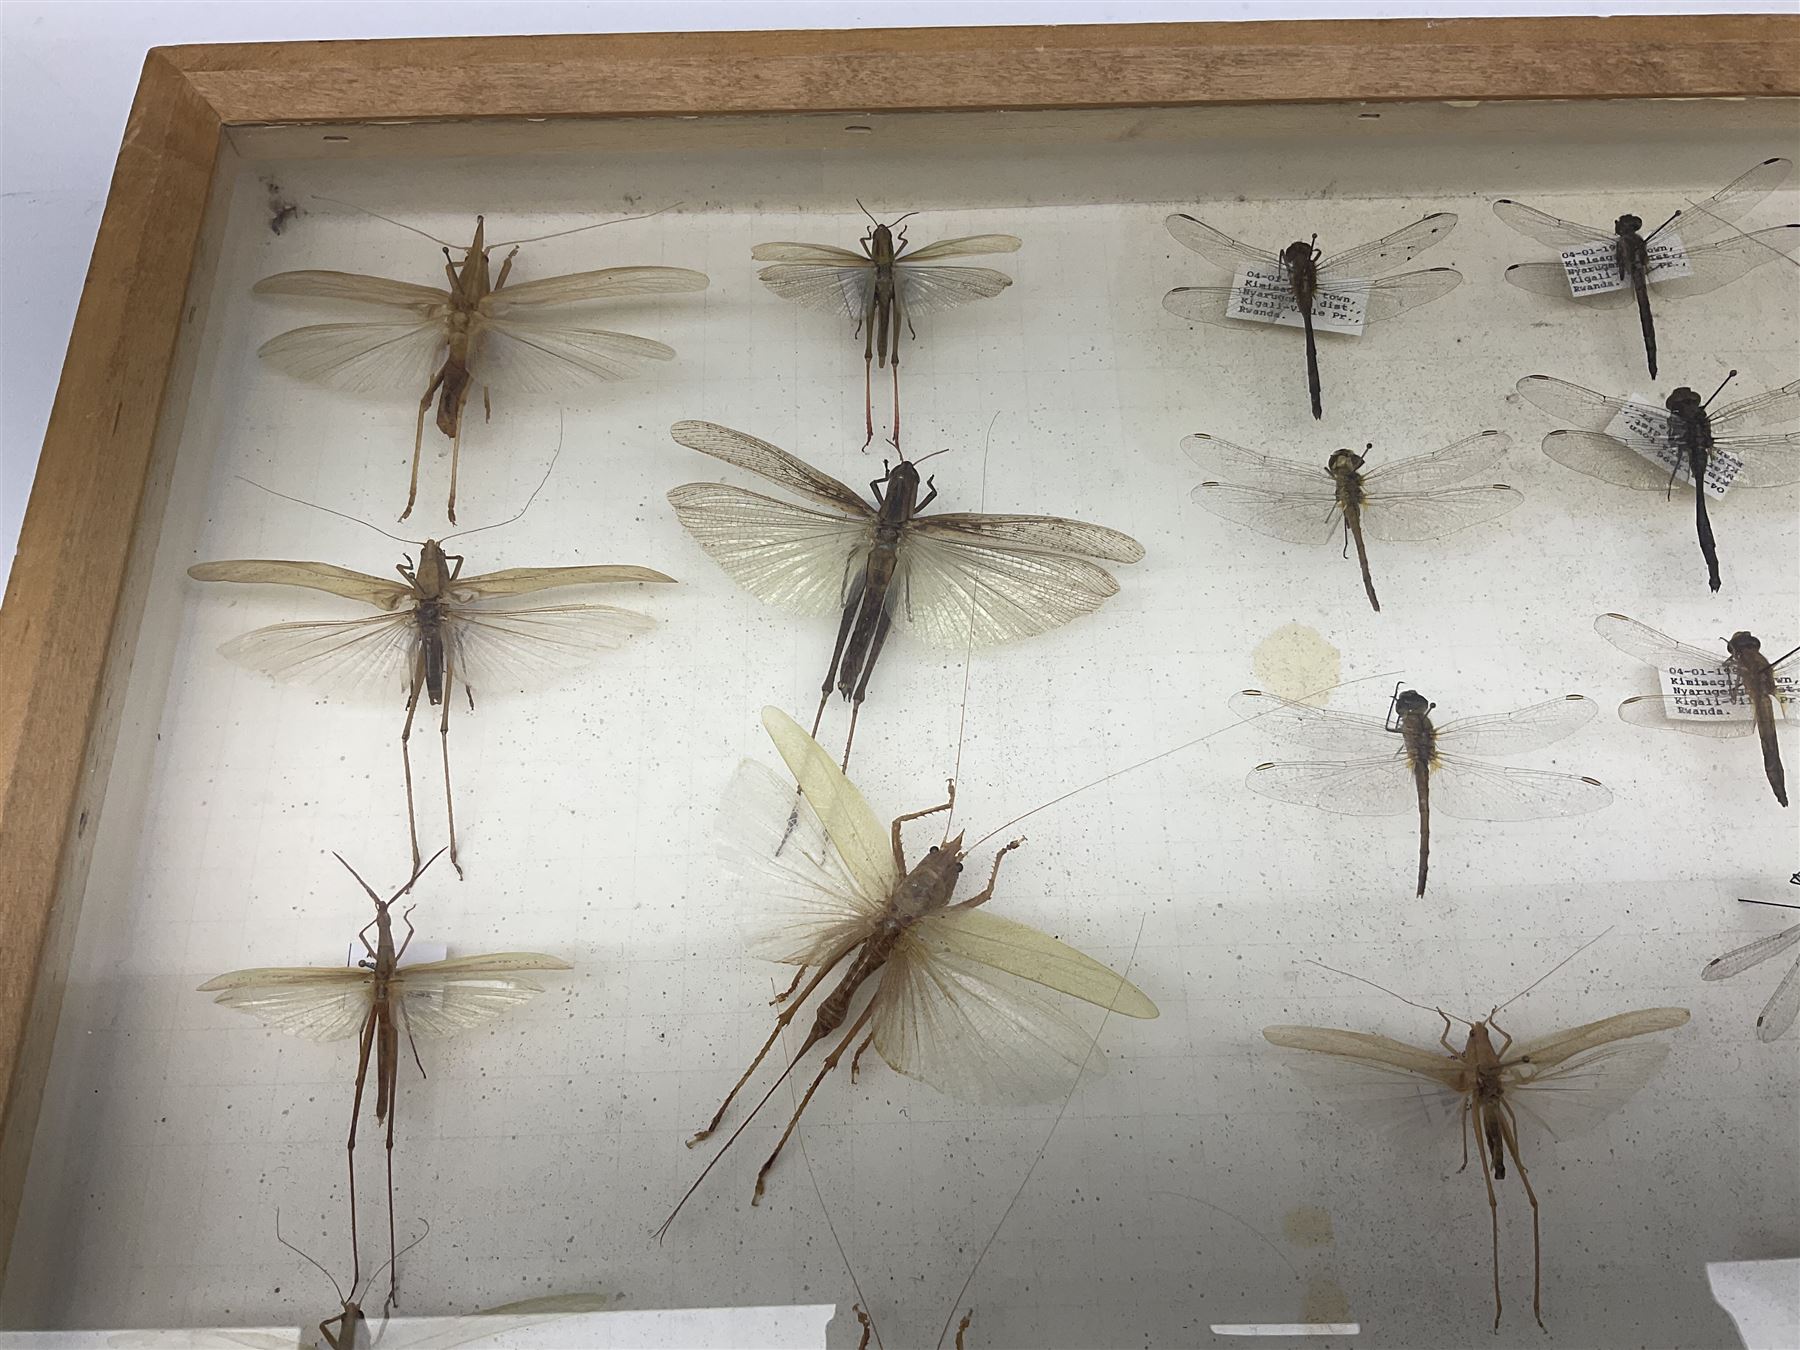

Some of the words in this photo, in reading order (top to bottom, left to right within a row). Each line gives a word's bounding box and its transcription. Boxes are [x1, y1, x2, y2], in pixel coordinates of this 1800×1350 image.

[1647, 245, 1674, 254] own,
[1573, 280, 1621, 293] Rwanda.
[1322, 292, 1356, 305] town,
[1238, 305, 1287, 320] Rwanda.
[1677, 706, 1731, 716] Rwanda.
